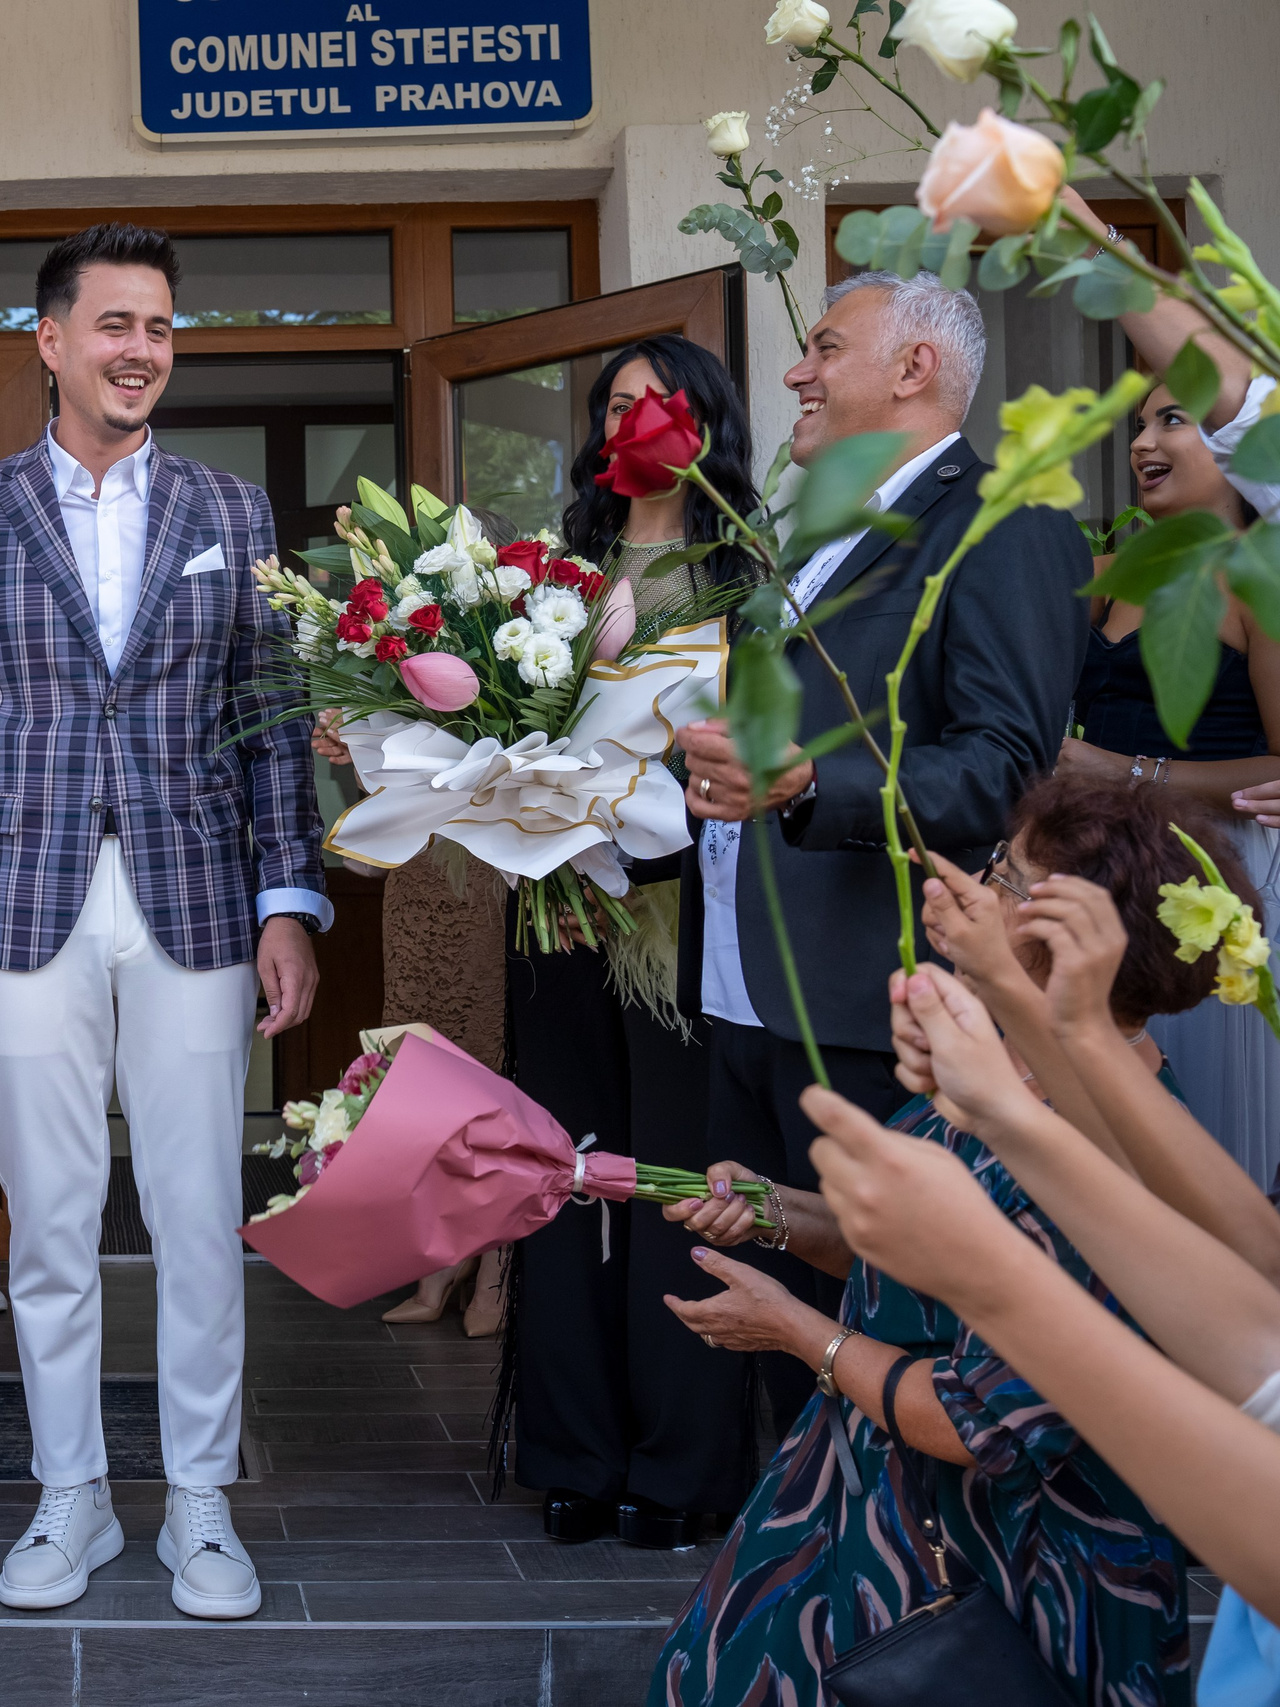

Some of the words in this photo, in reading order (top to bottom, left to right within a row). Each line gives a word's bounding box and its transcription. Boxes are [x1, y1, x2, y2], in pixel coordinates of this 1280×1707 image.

[346, 3, 380, 22] AL
[170, 31, 357, 74] COMUNEI
[371, 24, 560, 66] STEFESTI
[170, 87, 351, 120] JUDETUL
[375, 80, 562, 112] PRAHOVA
